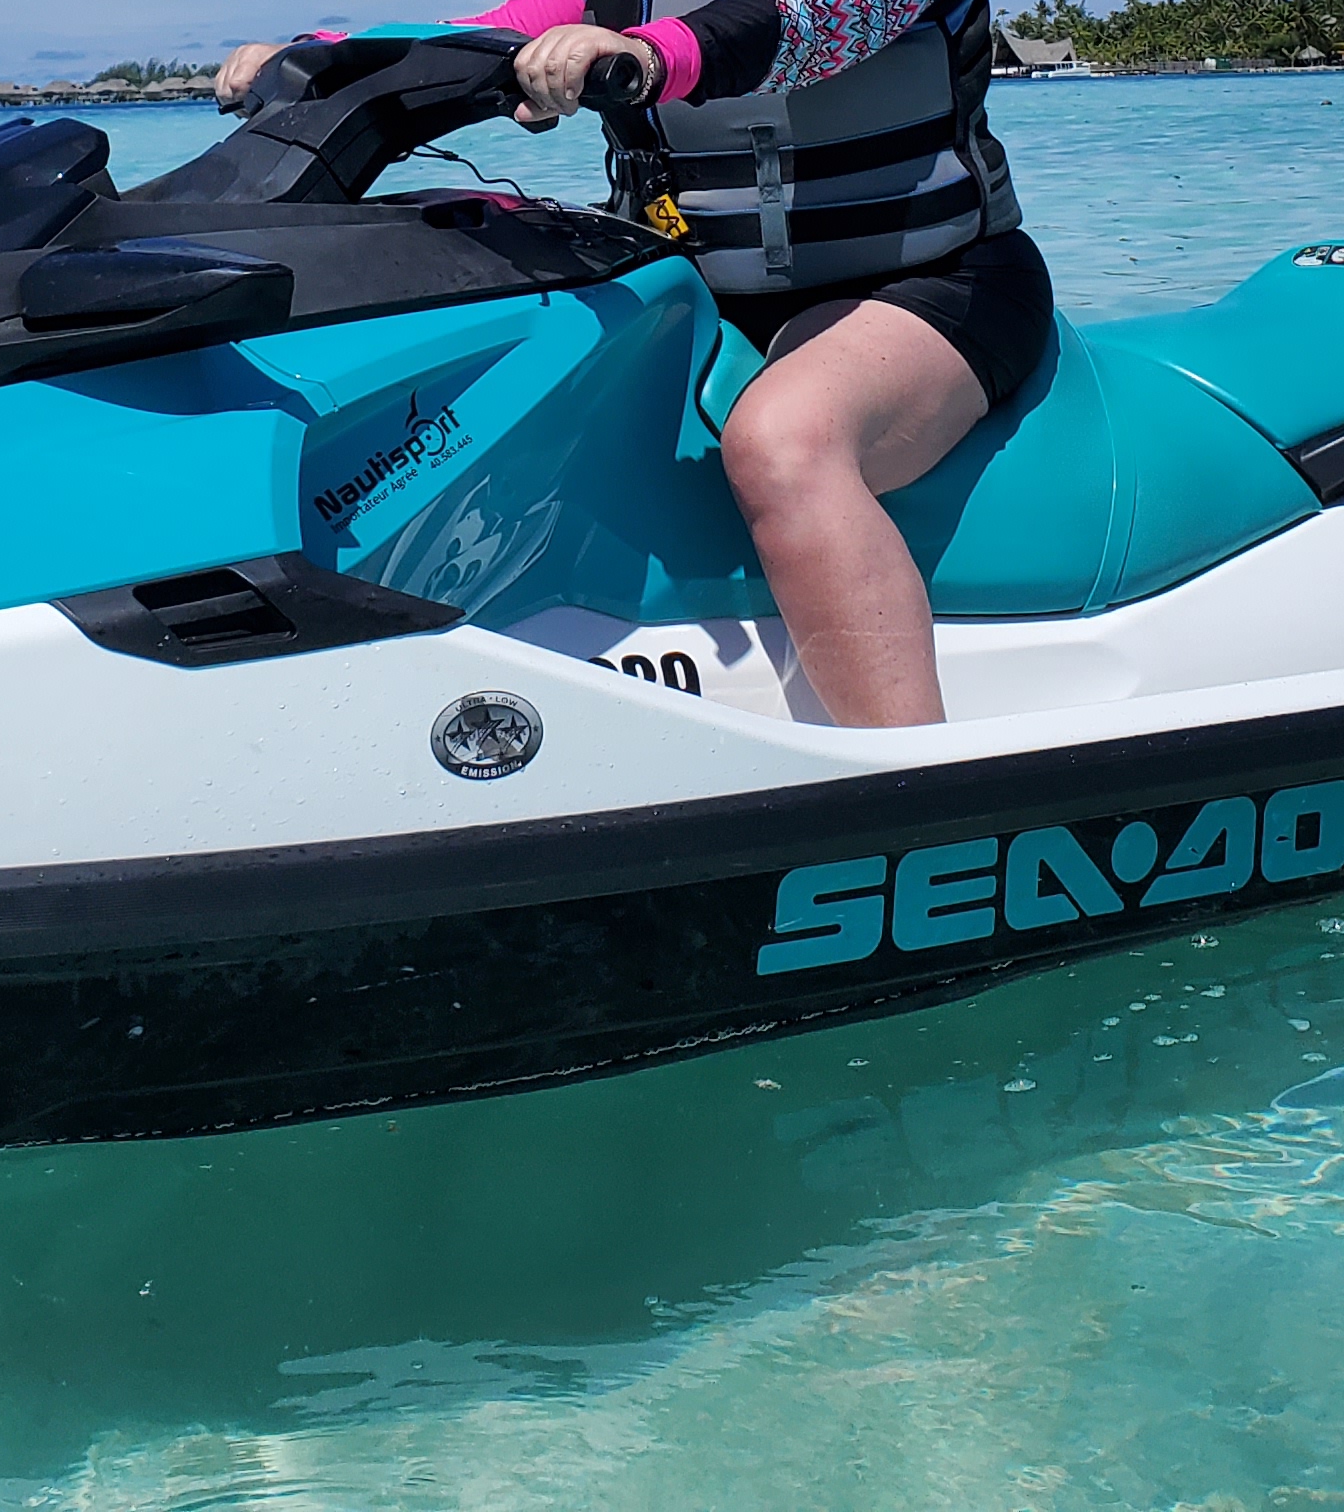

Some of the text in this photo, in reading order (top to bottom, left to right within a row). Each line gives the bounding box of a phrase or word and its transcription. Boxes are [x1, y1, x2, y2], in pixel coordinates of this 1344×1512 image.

[313, 405, 461, 521] Nautisport
[429, 434, 474, 470] 40.583.445
[330, 489, 390, 534] Importateur
[455, 695, 519, 712] ULTRA LOW
